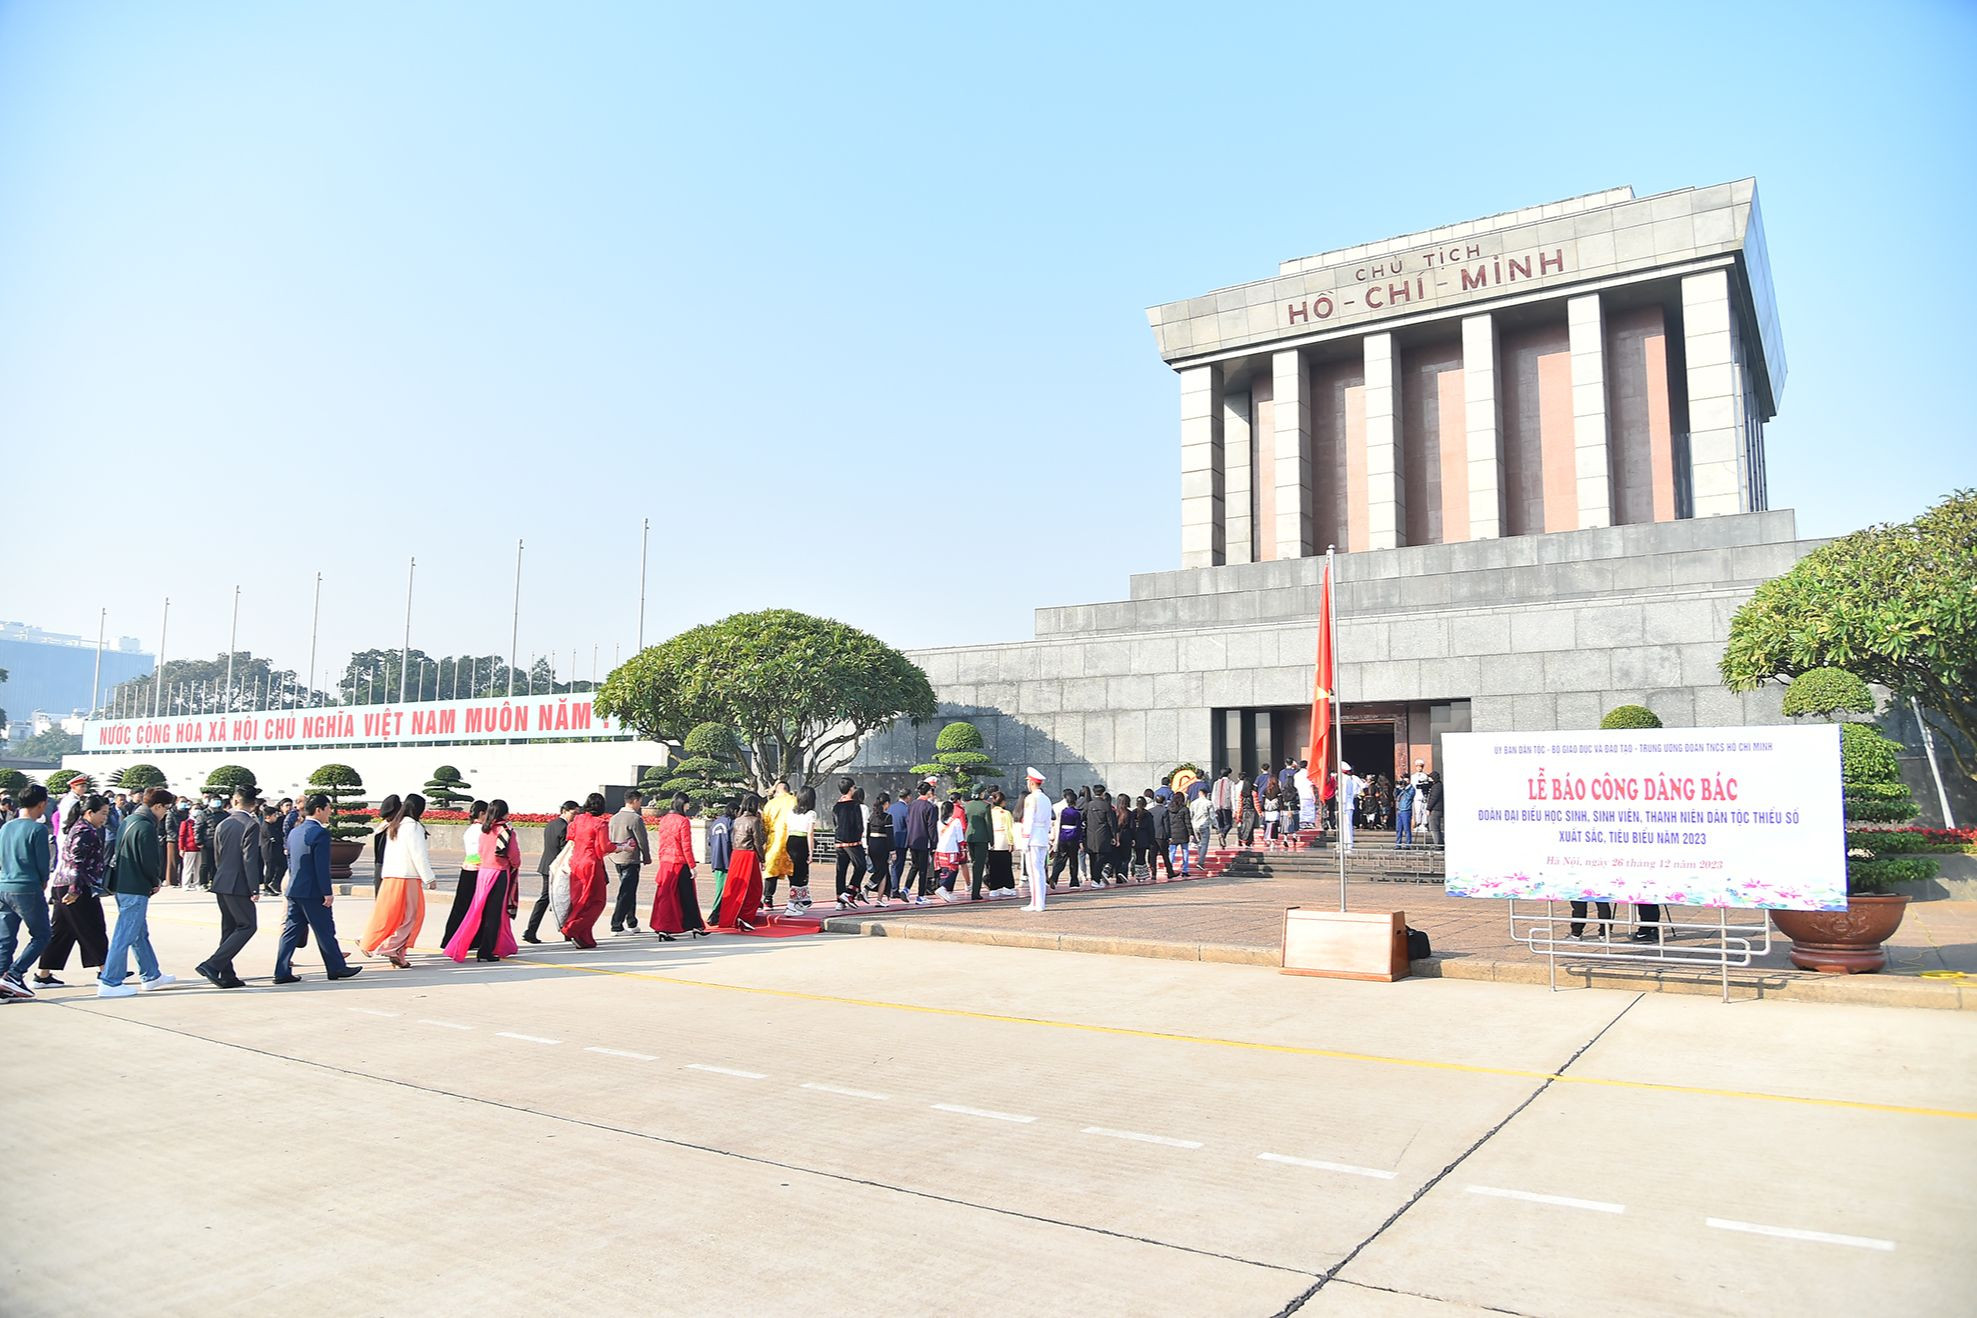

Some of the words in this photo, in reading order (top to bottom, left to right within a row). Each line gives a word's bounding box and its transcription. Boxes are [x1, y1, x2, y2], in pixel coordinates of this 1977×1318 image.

[1365, 271, 1425, 309] CHÍ
[100, 721, 131, 745] NƯỚC
[136, 720, 171, 748] CỘNG
[208, 716, 227, 742] XÃ
[233, 715, 259, 745] HỘI
[302, 710, 355, 739] NGHĨA
[364, 708, 403, 741] VIỆT
[411, 709, 456, 736] NAM
[465, 700, 530, 733] MUÔN
[538, 698, 591, 730] NĂM
[1528, 767, 1547, 800] LỄ
[1551, 771, 1587, 801] BÁO
[1591, 771, 1639, 801] CÔNG
[1643, 771, 1696, 801] DÂNG
[1701, 771, 1738, 800] BÁC
[1593, 810, 1616, 822] SINH
[1645, 810, 1678, 823] THANH
[1683, 832, 1707, 845] 2023
[1611, 856, 1625, 868] 26
[1659, 859, 1672, 869] 12
